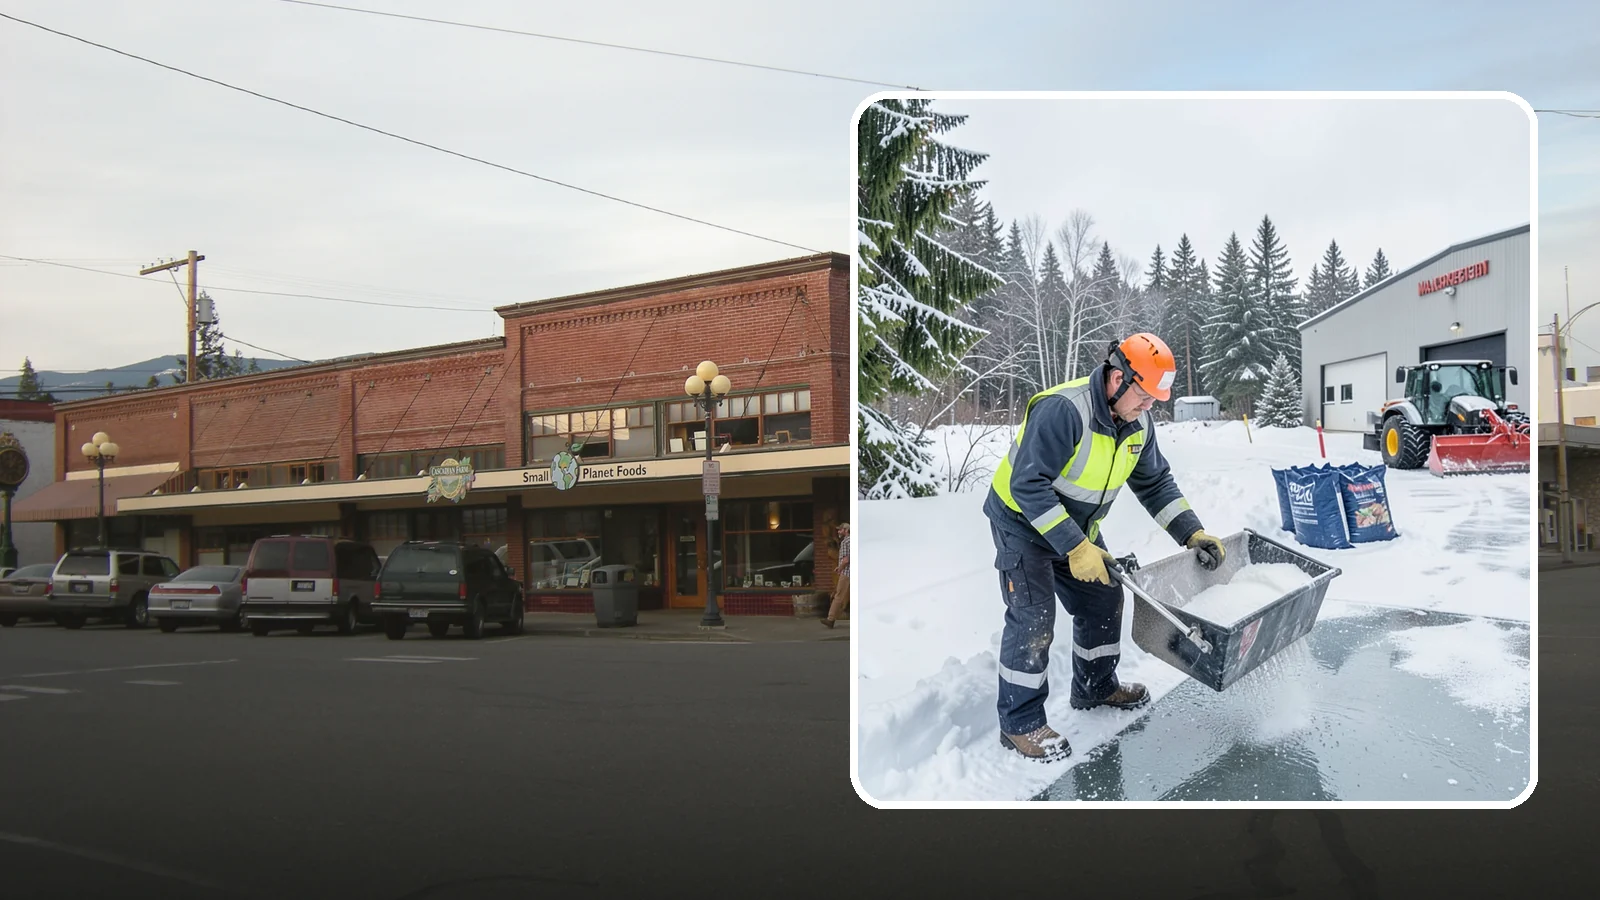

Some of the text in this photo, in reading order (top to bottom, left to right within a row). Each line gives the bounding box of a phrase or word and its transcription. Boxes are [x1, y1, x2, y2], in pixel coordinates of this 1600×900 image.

[523, 464, 647, 483] Small Planet Foods
